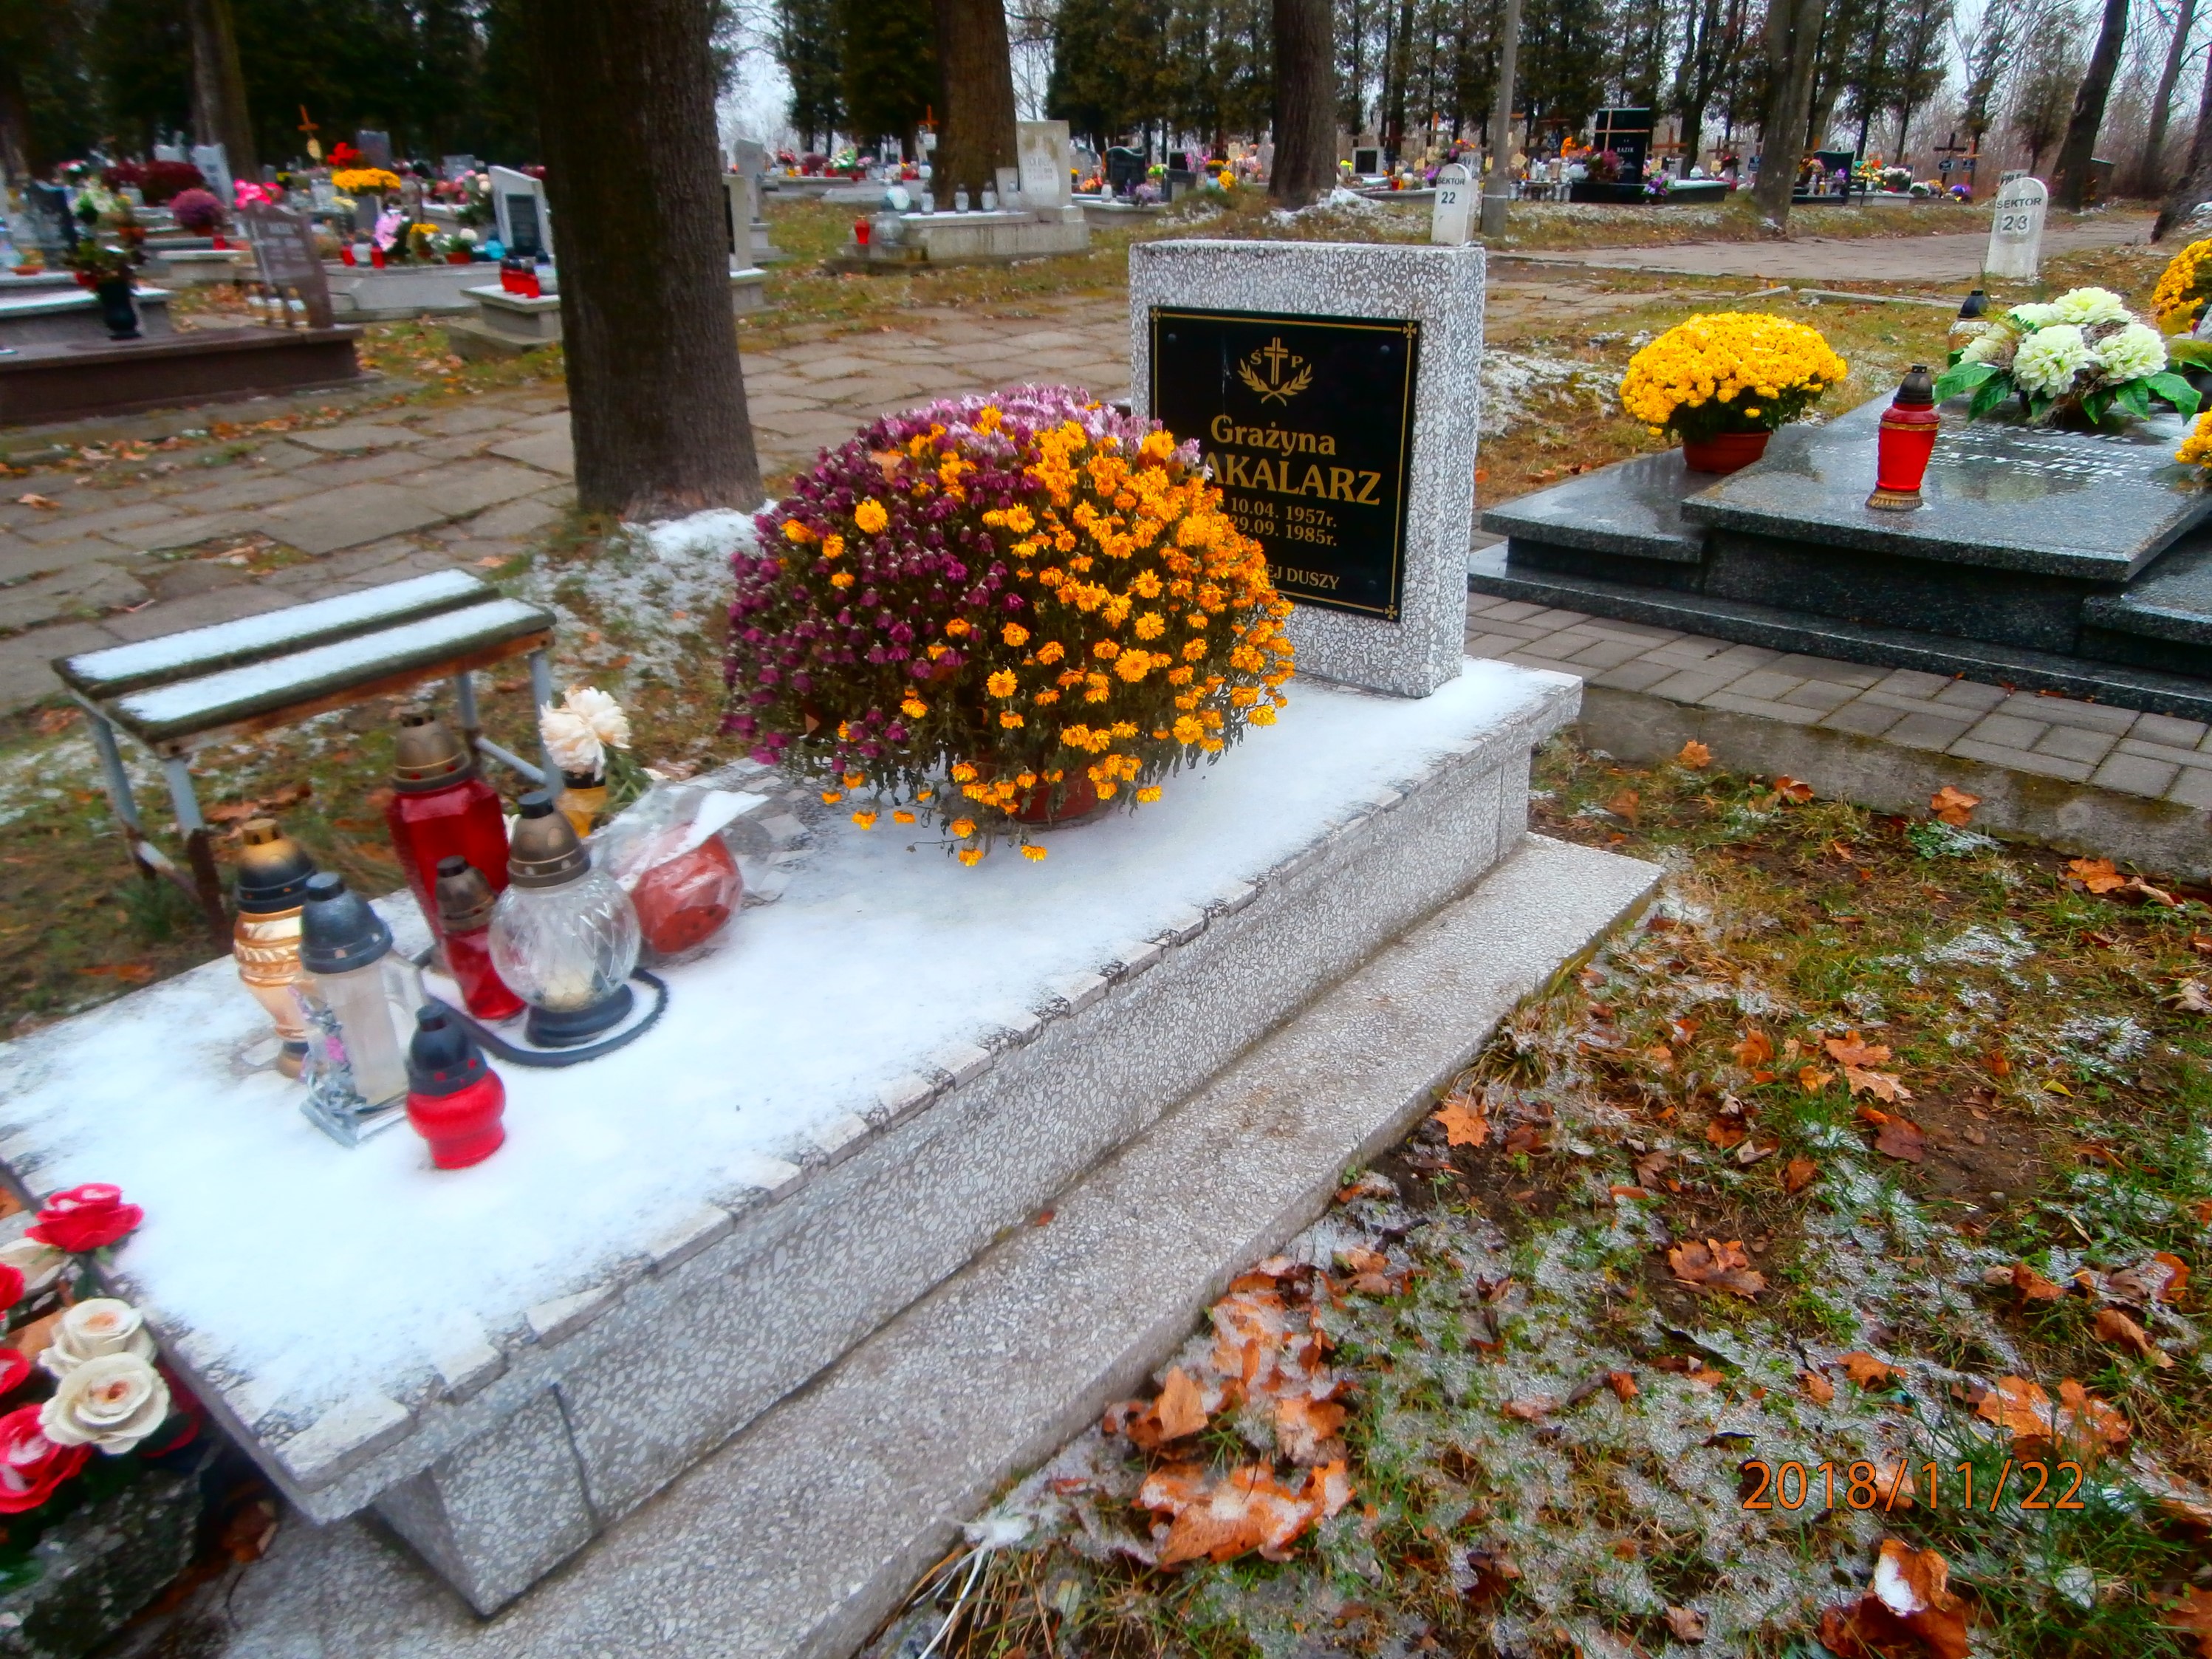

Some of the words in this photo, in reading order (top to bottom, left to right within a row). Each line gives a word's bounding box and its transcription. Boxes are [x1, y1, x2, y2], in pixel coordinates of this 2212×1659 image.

[1437, 177, 1465, 185] SEKTOR
[1441, 191, 1456, 204] 22
[1996, 197, 2041, 209] SEKTOR
[2002, 215, 2028, 231] 23
[1291, 355, 1304, 368] P
[1211, 414, 1337, 456] Grażyna
[1182, 451, 1381, 506] AKALARZ
[1230, 497, 1279, 520] 10.04.
[1286, 505, 1338, 528] 1957r.
[1286, 523, 1338, 547] 1985r.
[1264, 564, 1282, 580] EJ
[1287, 565, 1340, 590] DUSZY
